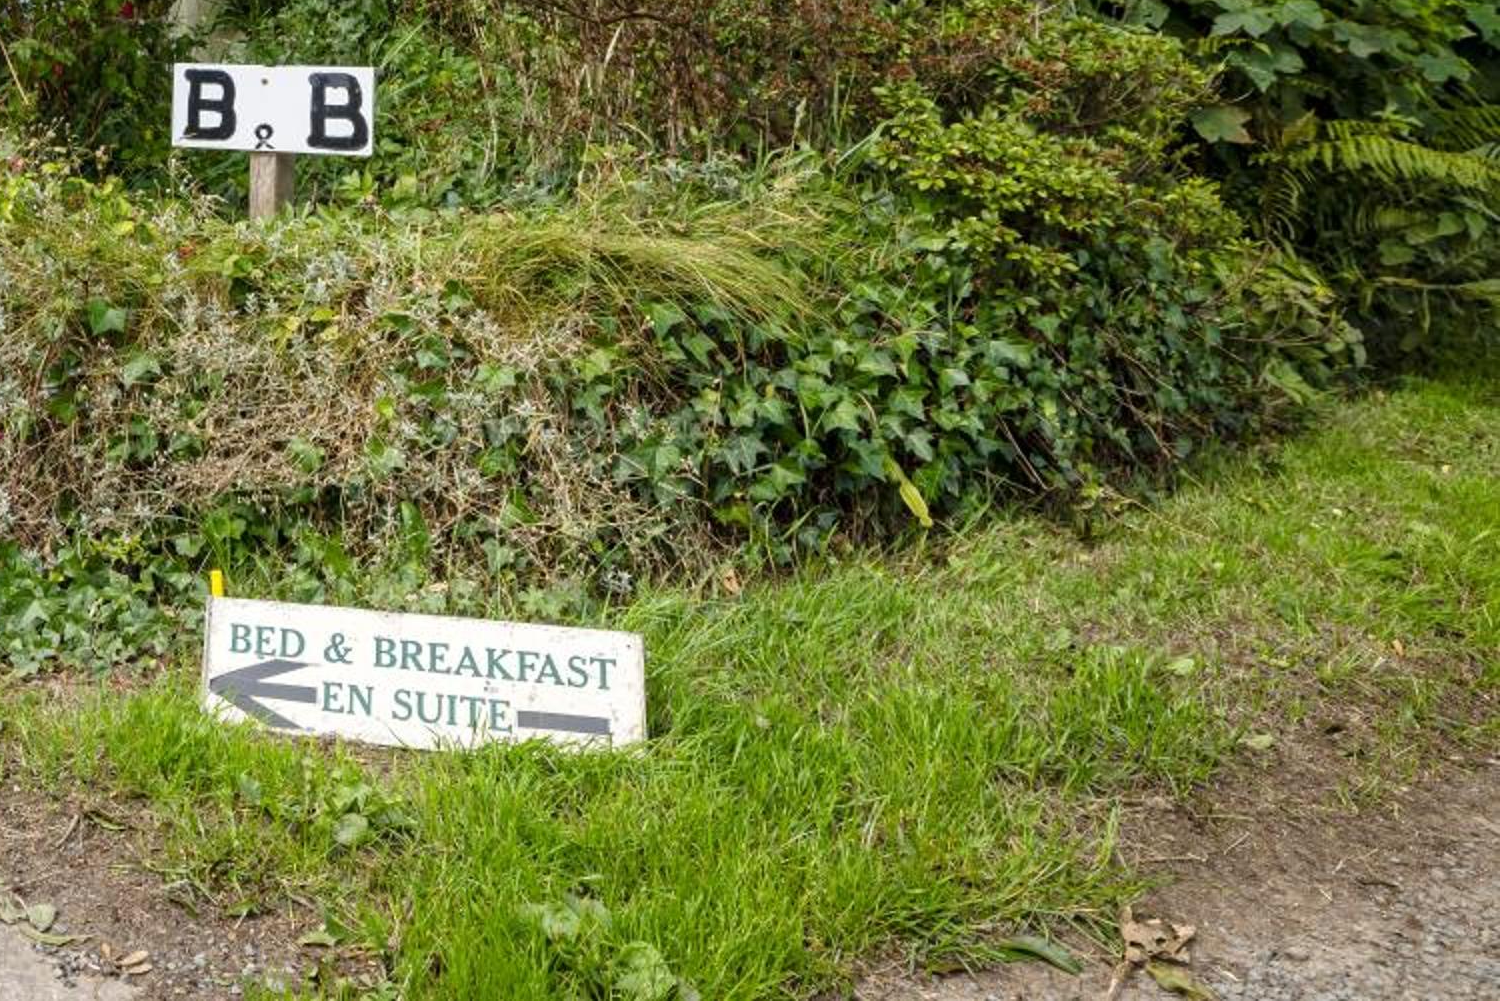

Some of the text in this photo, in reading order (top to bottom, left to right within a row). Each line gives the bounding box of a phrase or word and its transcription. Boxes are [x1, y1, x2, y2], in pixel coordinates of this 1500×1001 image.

[183, 69, 237, 140] B
[307, 72, 369, 151] B
[229, 623, 617, 691] BED & BREAKFAST
[321, 682, 513, 734] EN SUITE
